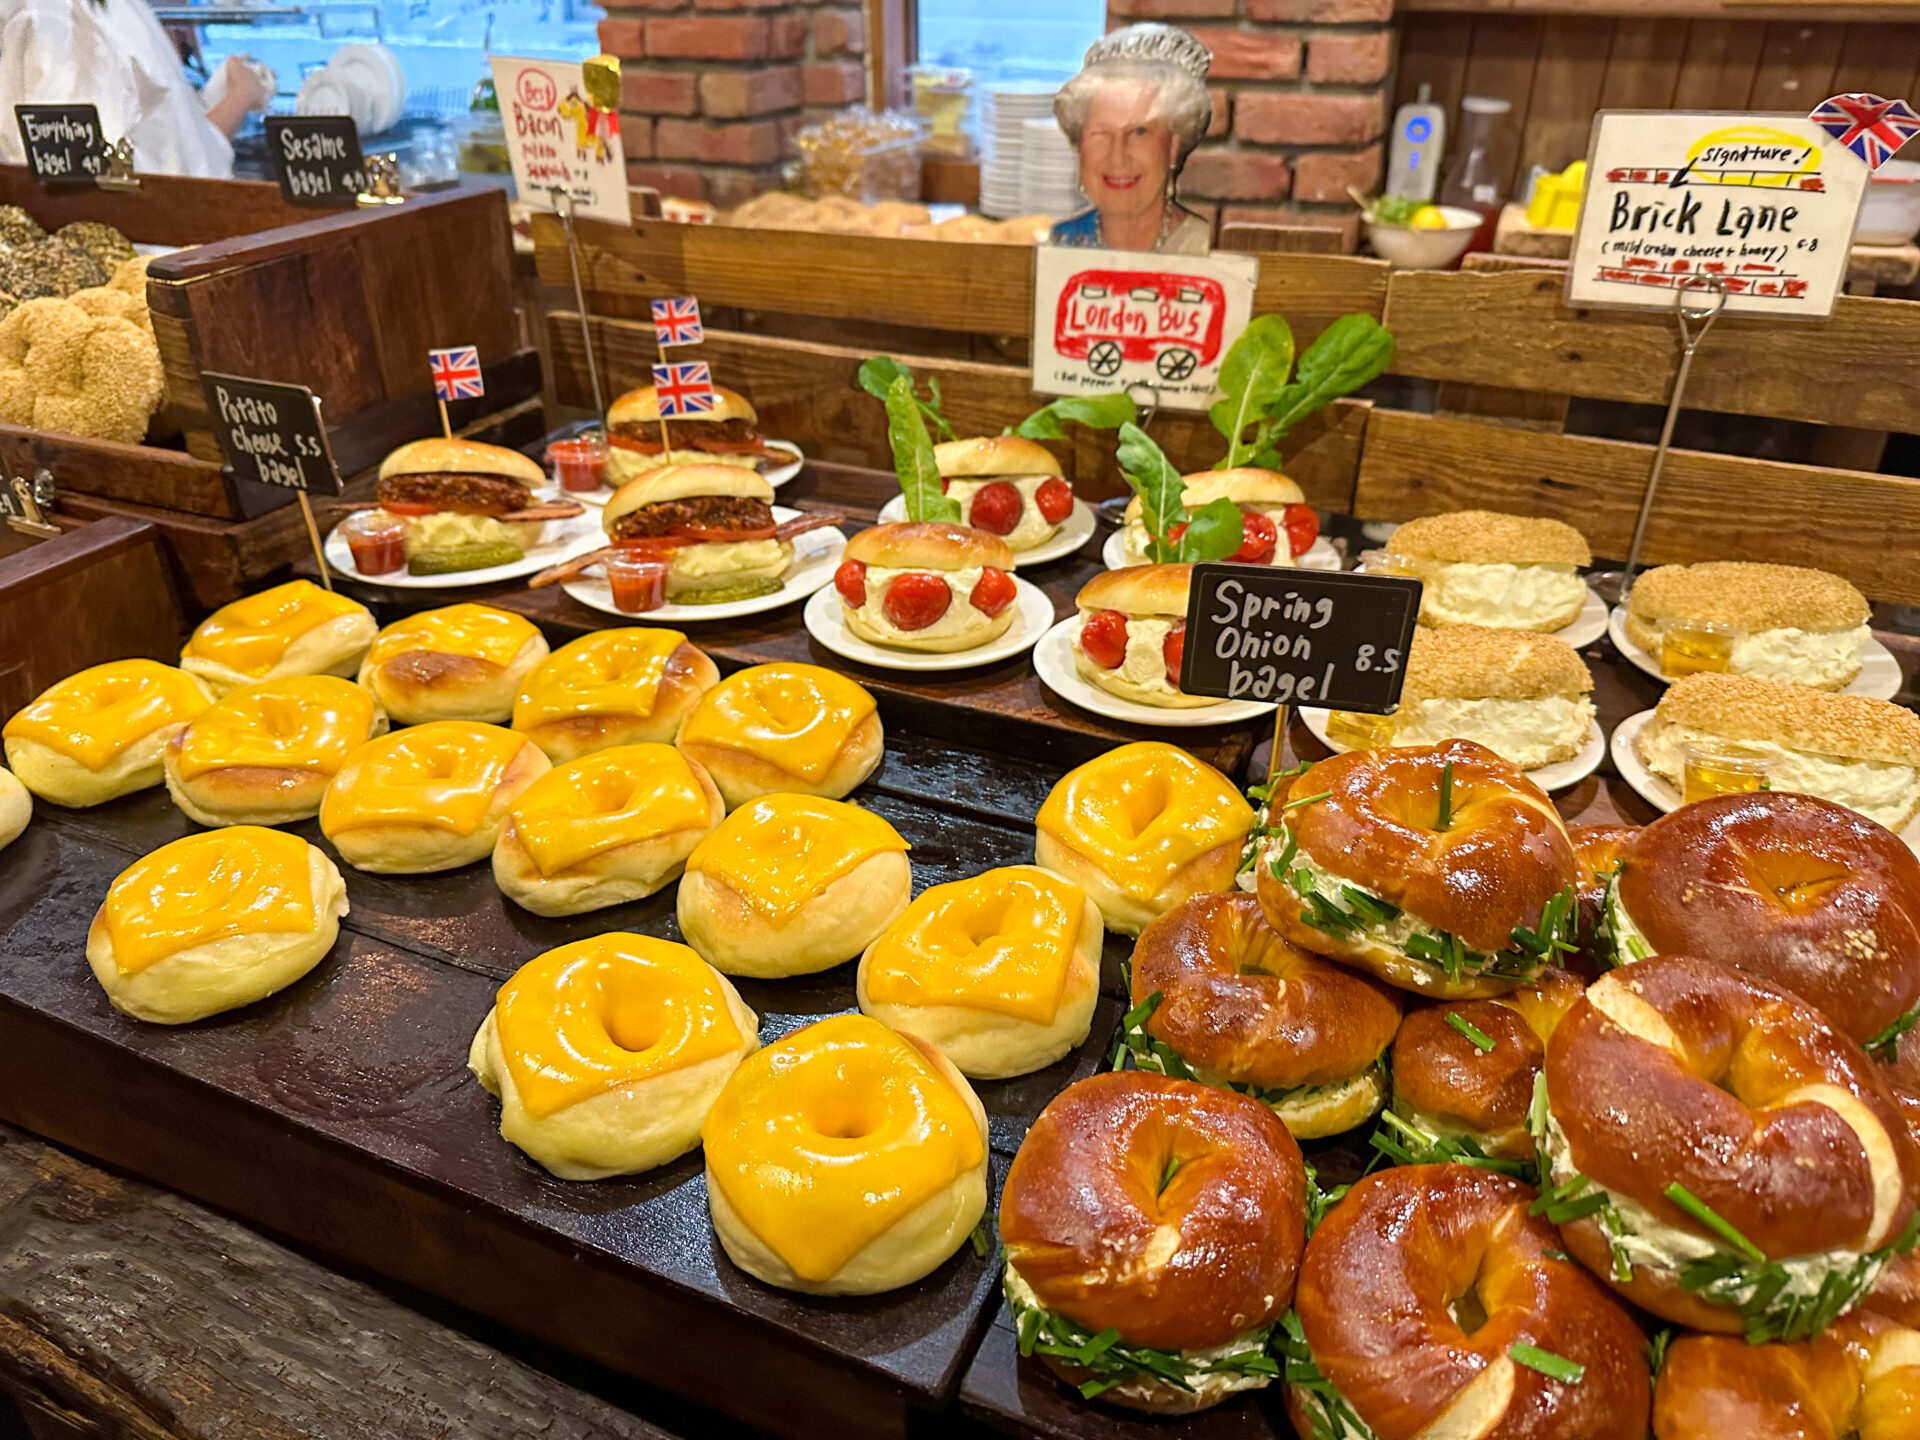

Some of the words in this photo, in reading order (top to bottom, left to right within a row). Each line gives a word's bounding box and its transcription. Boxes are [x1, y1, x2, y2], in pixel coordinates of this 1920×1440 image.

[32, 145, 72, 176] bagel
[280, 128, 346, 161] Sesame
[286, 164, 332, 197] bagel
[1609, 191, 1702, 234] Brick
[1716, 197, 1799, 239] Lane
[1069, 300, 1148, 335] London
[1157, 301, 1201, 337] Bus
[215, 385, 278, 426] Potato
[255, 453, 308, 489] bagel
[1210, 579, 1334, 629] Spring
[1215, 626, 1312, 661] Onion
[1355, 644, 1402, 673] 8.5
[1228, 659, 1335, 703] bagel
